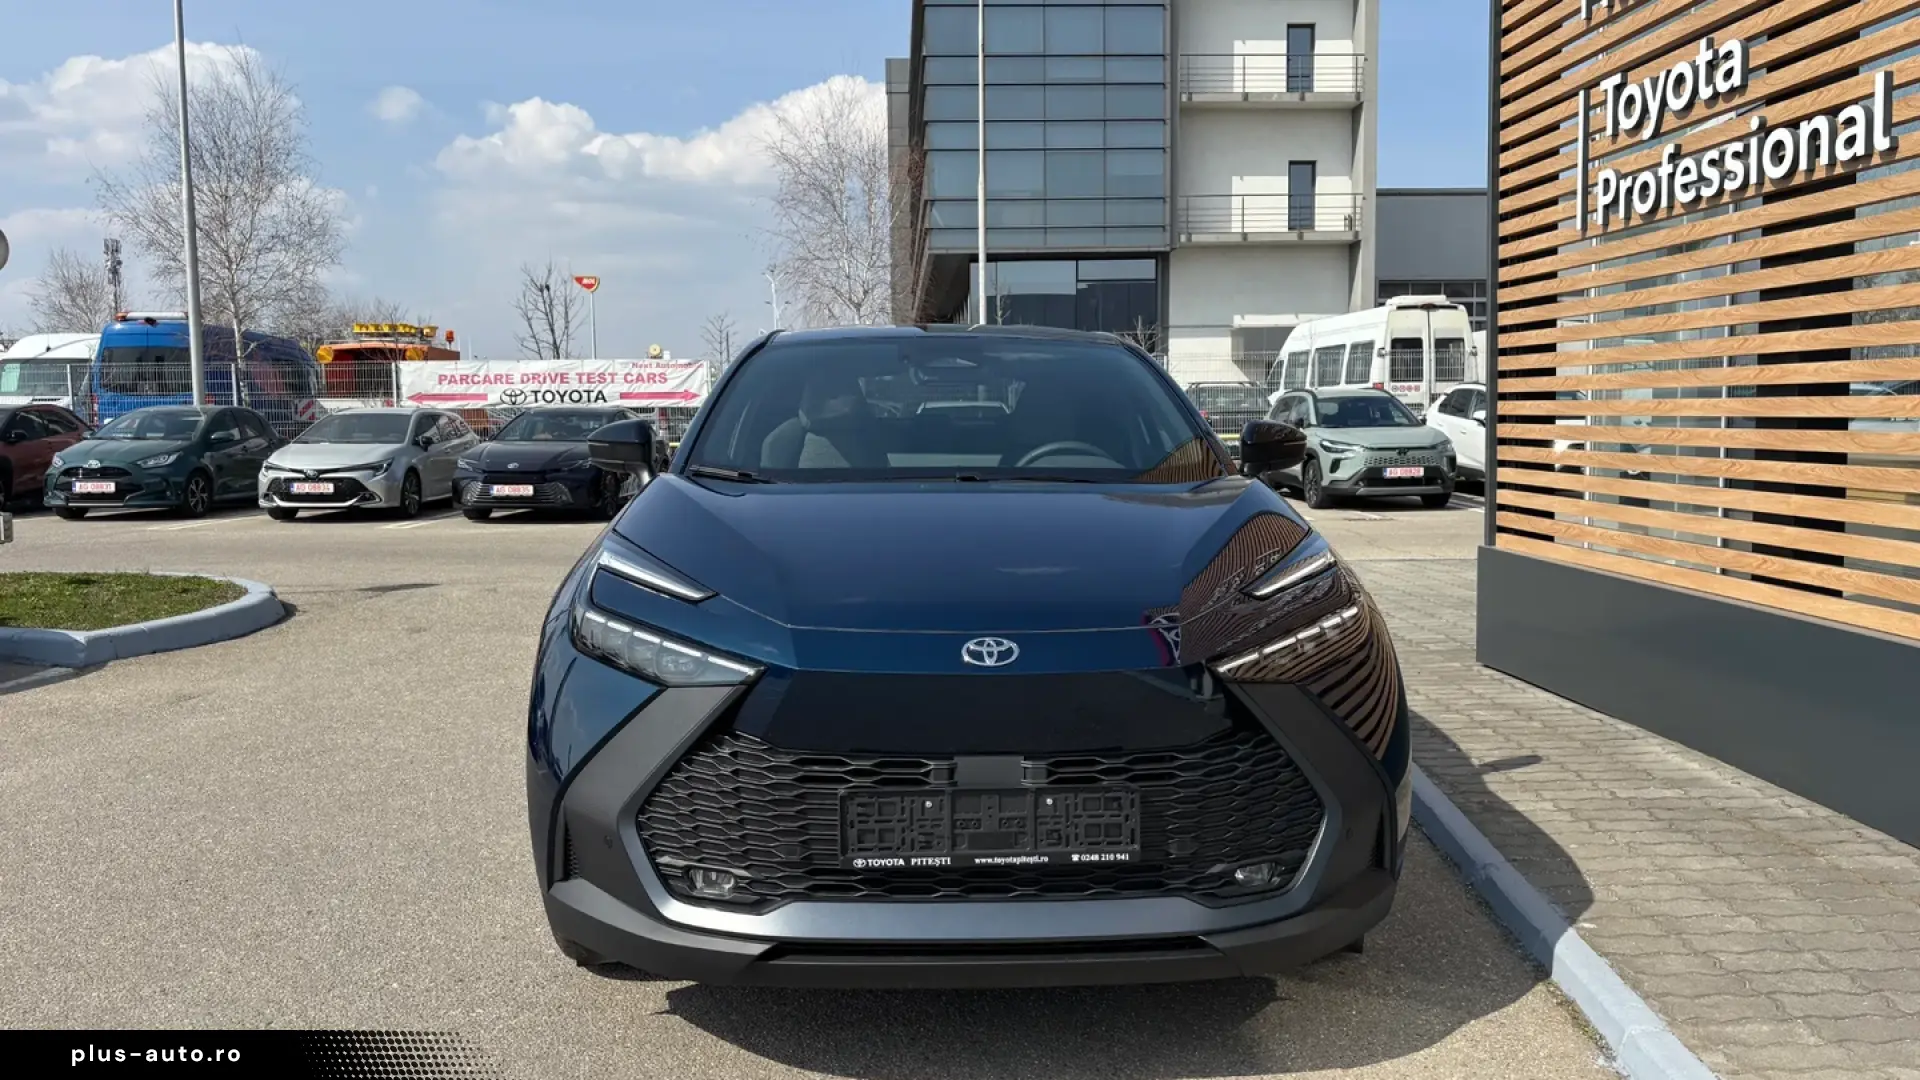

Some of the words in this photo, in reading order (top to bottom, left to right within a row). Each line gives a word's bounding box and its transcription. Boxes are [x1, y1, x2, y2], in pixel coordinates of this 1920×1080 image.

[1600, 36, 1750, 140] Toyota
[1596, 70, 1899, 226] Professional
[438, 373, 515, 385] PARCARE
[519, 372, 569, 385] DRIVE
[576, 372, 618, 385] TEST
[622, 372, 668, 384] CARS
[530, 389, 608, 404] TOYOTA
[867, 858, 905, 867] TOYOTA
[1080, 854, 1099, 862] 0248
[1101, 853, 1114, 861] 210
[1116, 853, 1129, 861] 941
